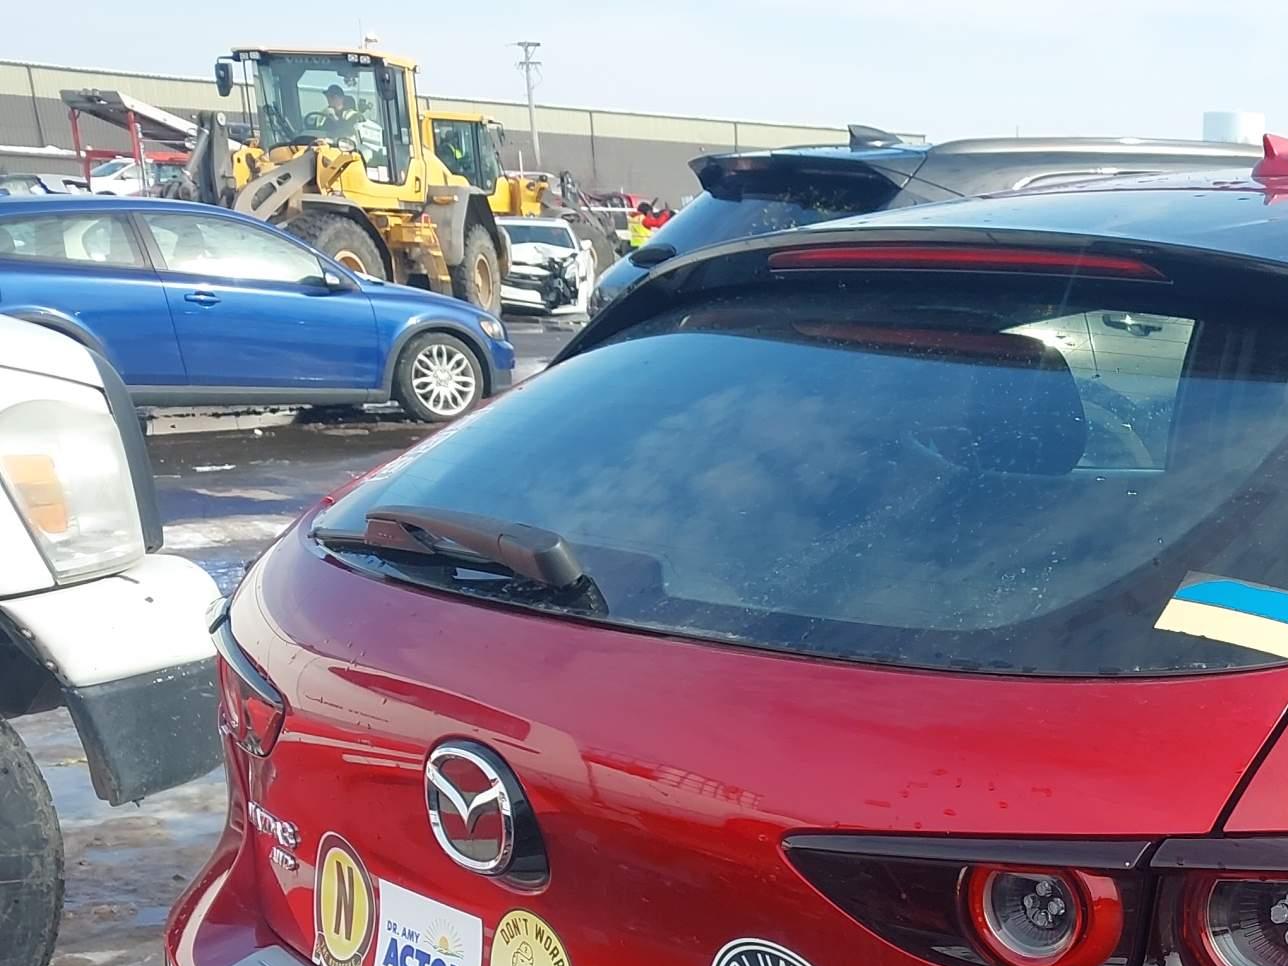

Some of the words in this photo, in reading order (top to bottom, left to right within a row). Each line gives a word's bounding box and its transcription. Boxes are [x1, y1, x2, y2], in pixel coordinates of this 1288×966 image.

[333, 860, 354, 942] N
[387, 920, 399, 935] DR.
[401, 927, 420, 943] AMY
[500, 918, 529, 945] DON'T
